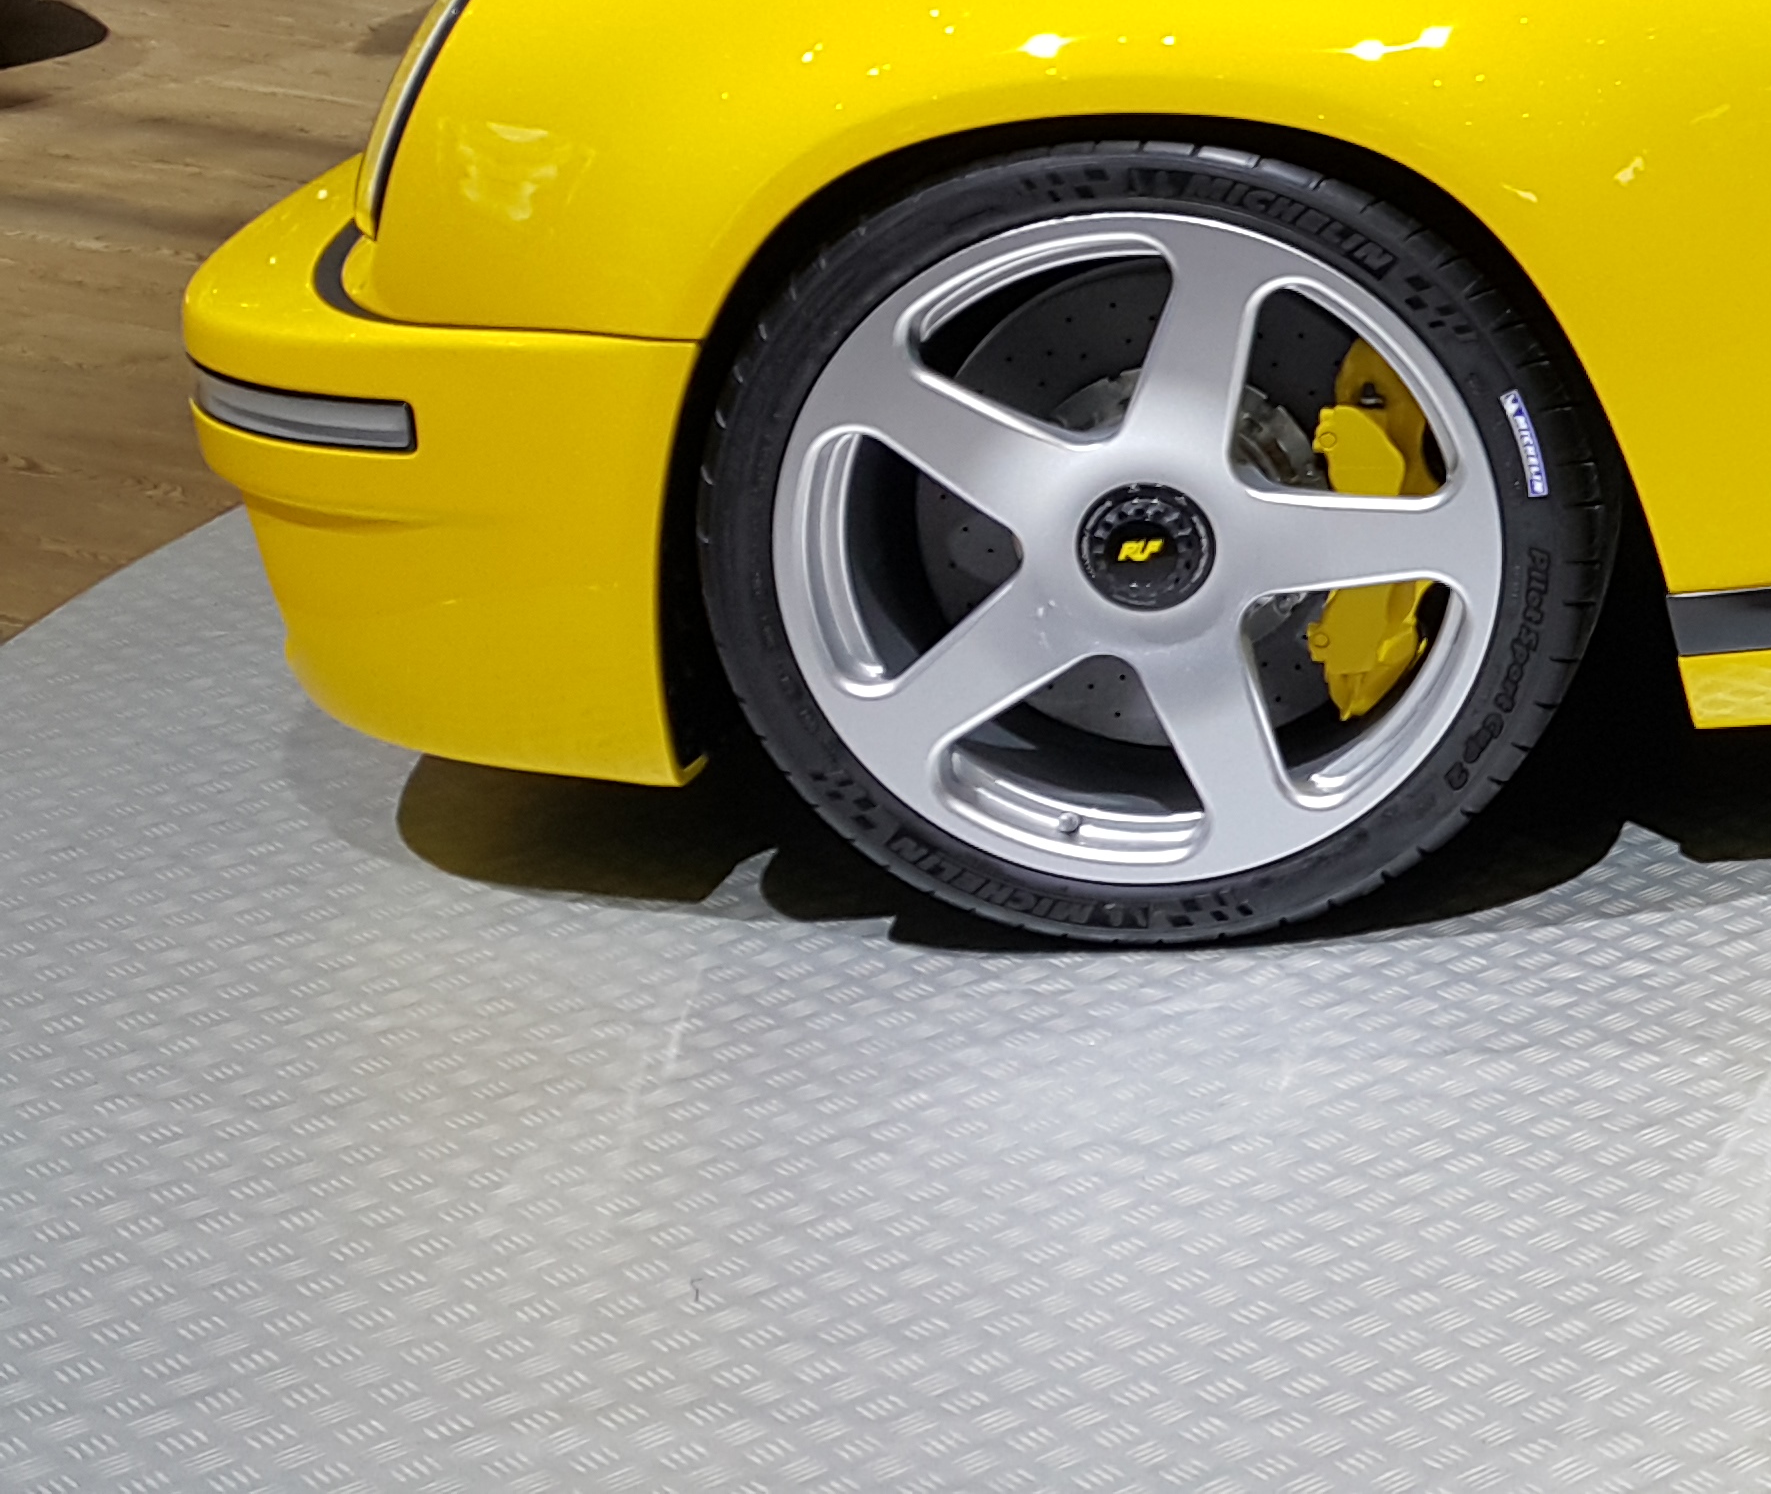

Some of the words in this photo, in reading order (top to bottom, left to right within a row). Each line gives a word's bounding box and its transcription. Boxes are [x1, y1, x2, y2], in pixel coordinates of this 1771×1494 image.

[1184, 173, 1395, 271] MICHELIN
[1513, 415, 1545, 495] MICHELIN
[1117, 539, 1164, 562] RUF
[890, 835, 1098, 925] MICHELIN
